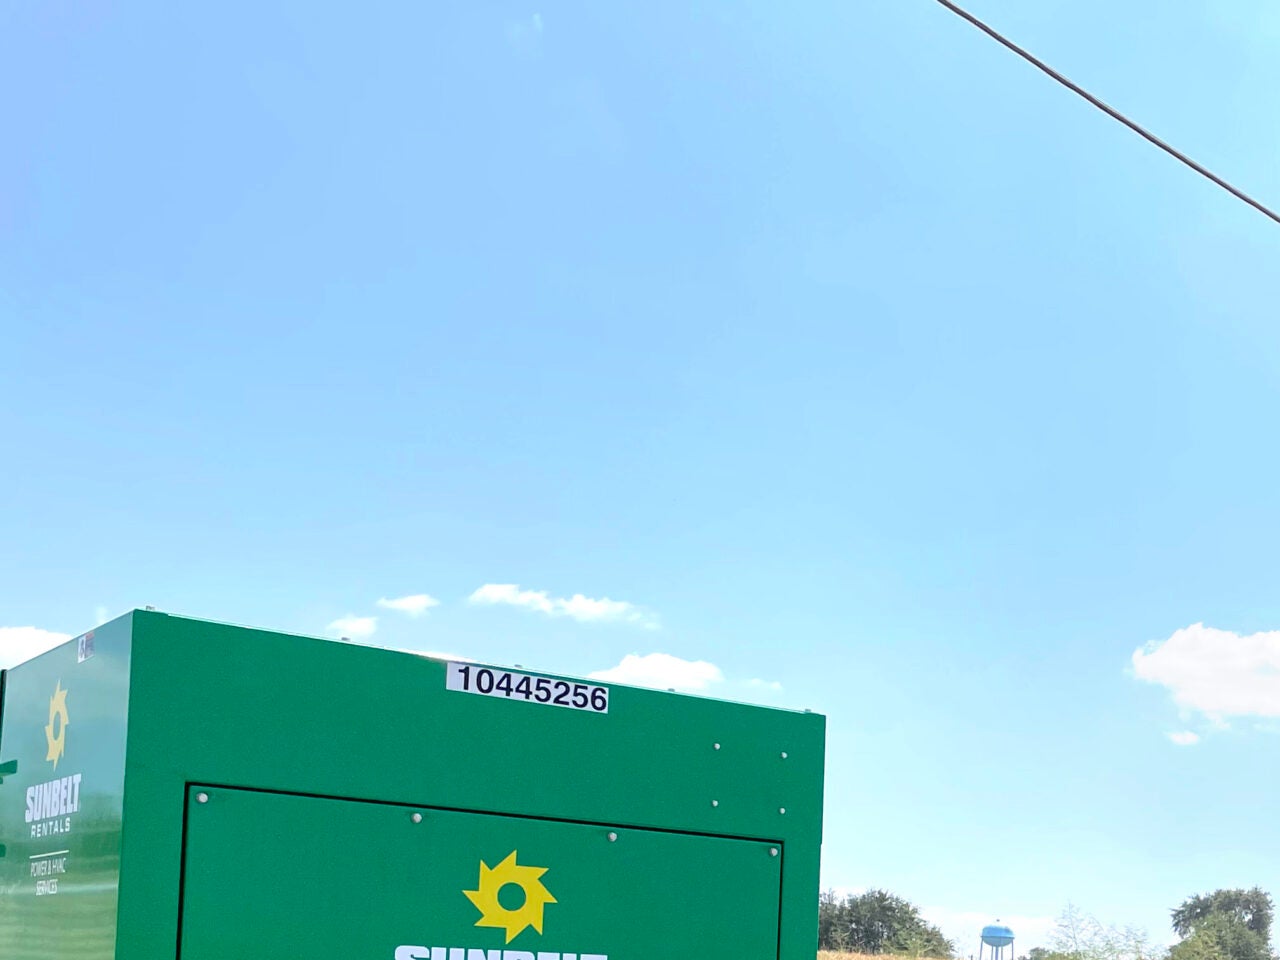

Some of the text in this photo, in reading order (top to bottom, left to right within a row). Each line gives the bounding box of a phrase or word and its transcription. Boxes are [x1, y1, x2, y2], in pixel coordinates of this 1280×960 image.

[458, 666, 607, 711] 10445256
[25, 773, 81, 823] SUNBELT
[30, 817, 71, 838] RENTALS
